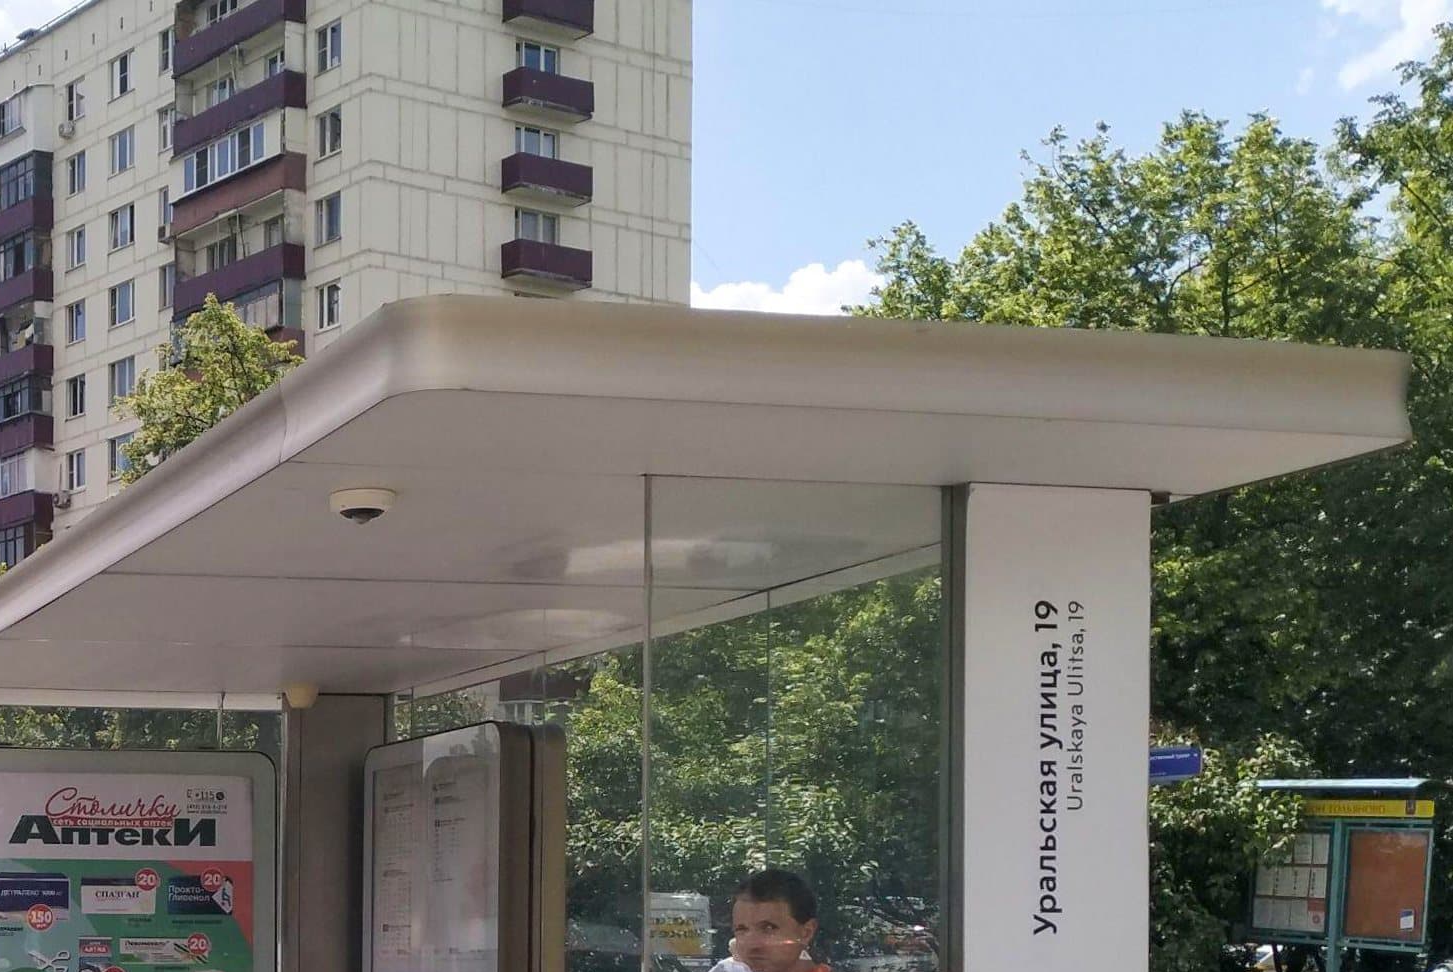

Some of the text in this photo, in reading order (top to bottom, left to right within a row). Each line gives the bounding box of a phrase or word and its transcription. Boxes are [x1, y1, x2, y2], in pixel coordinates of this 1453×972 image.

[45, 787, 182, 817] Столички
[1033, 600, 1063, 935] Уральская улица, 19
[1066, 601, 1087, 811] Uralskaya Ulitsa, 19
